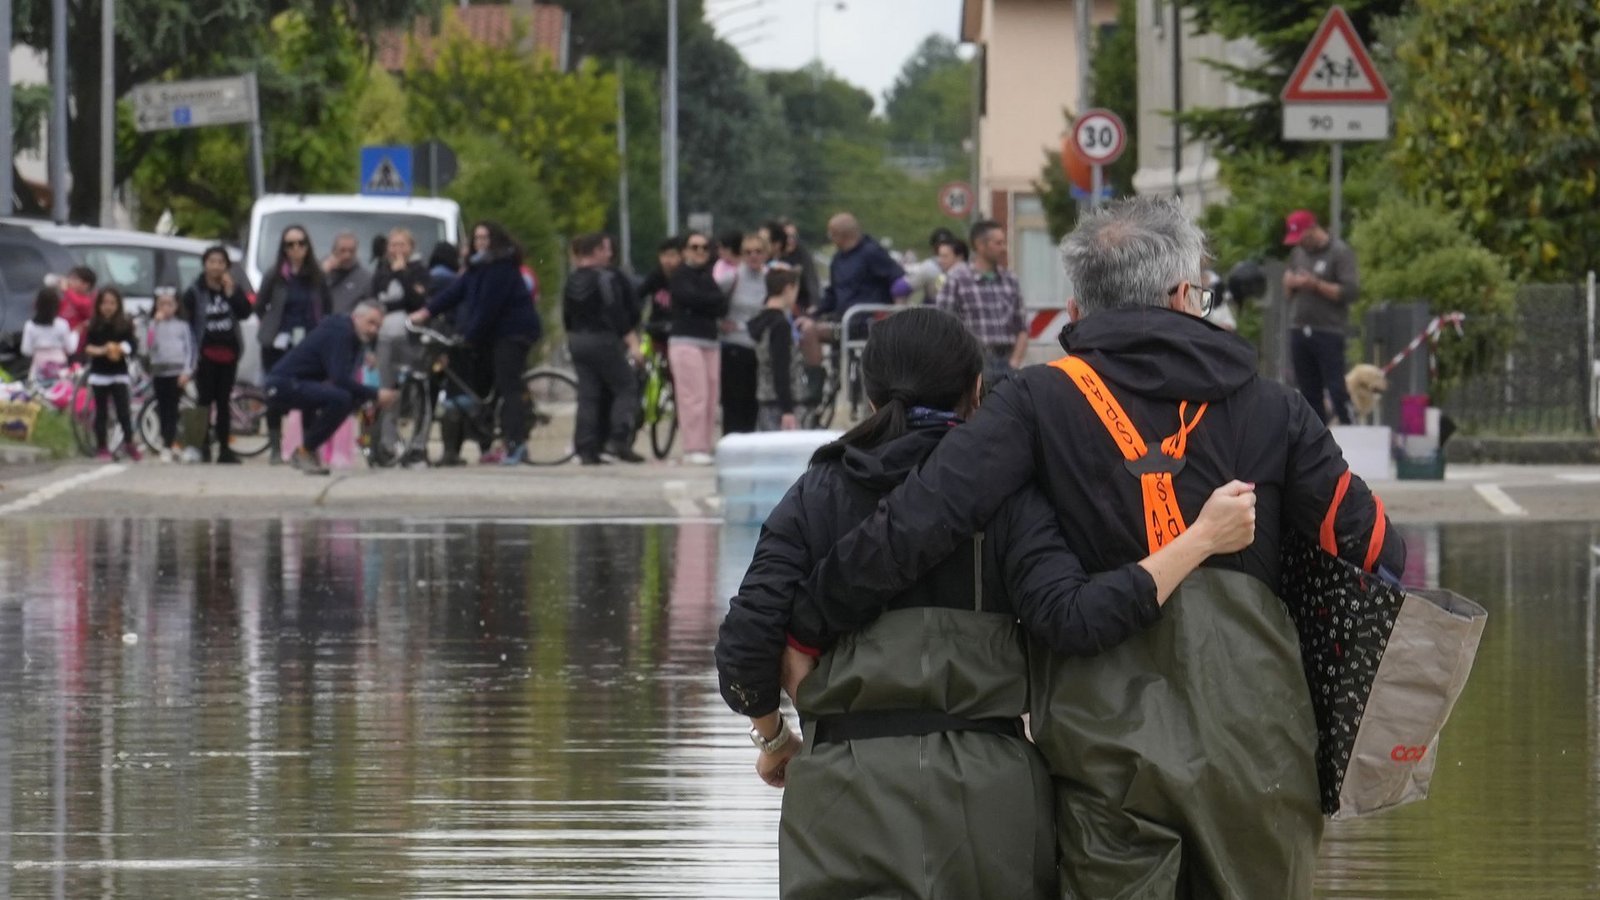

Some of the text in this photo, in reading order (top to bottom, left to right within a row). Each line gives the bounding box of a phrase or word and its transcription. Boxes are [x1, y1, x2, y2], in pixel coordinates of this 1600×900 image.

[1309, 114, 1362, 131] 90 m
[1084, 125, 1113, 148] 30
